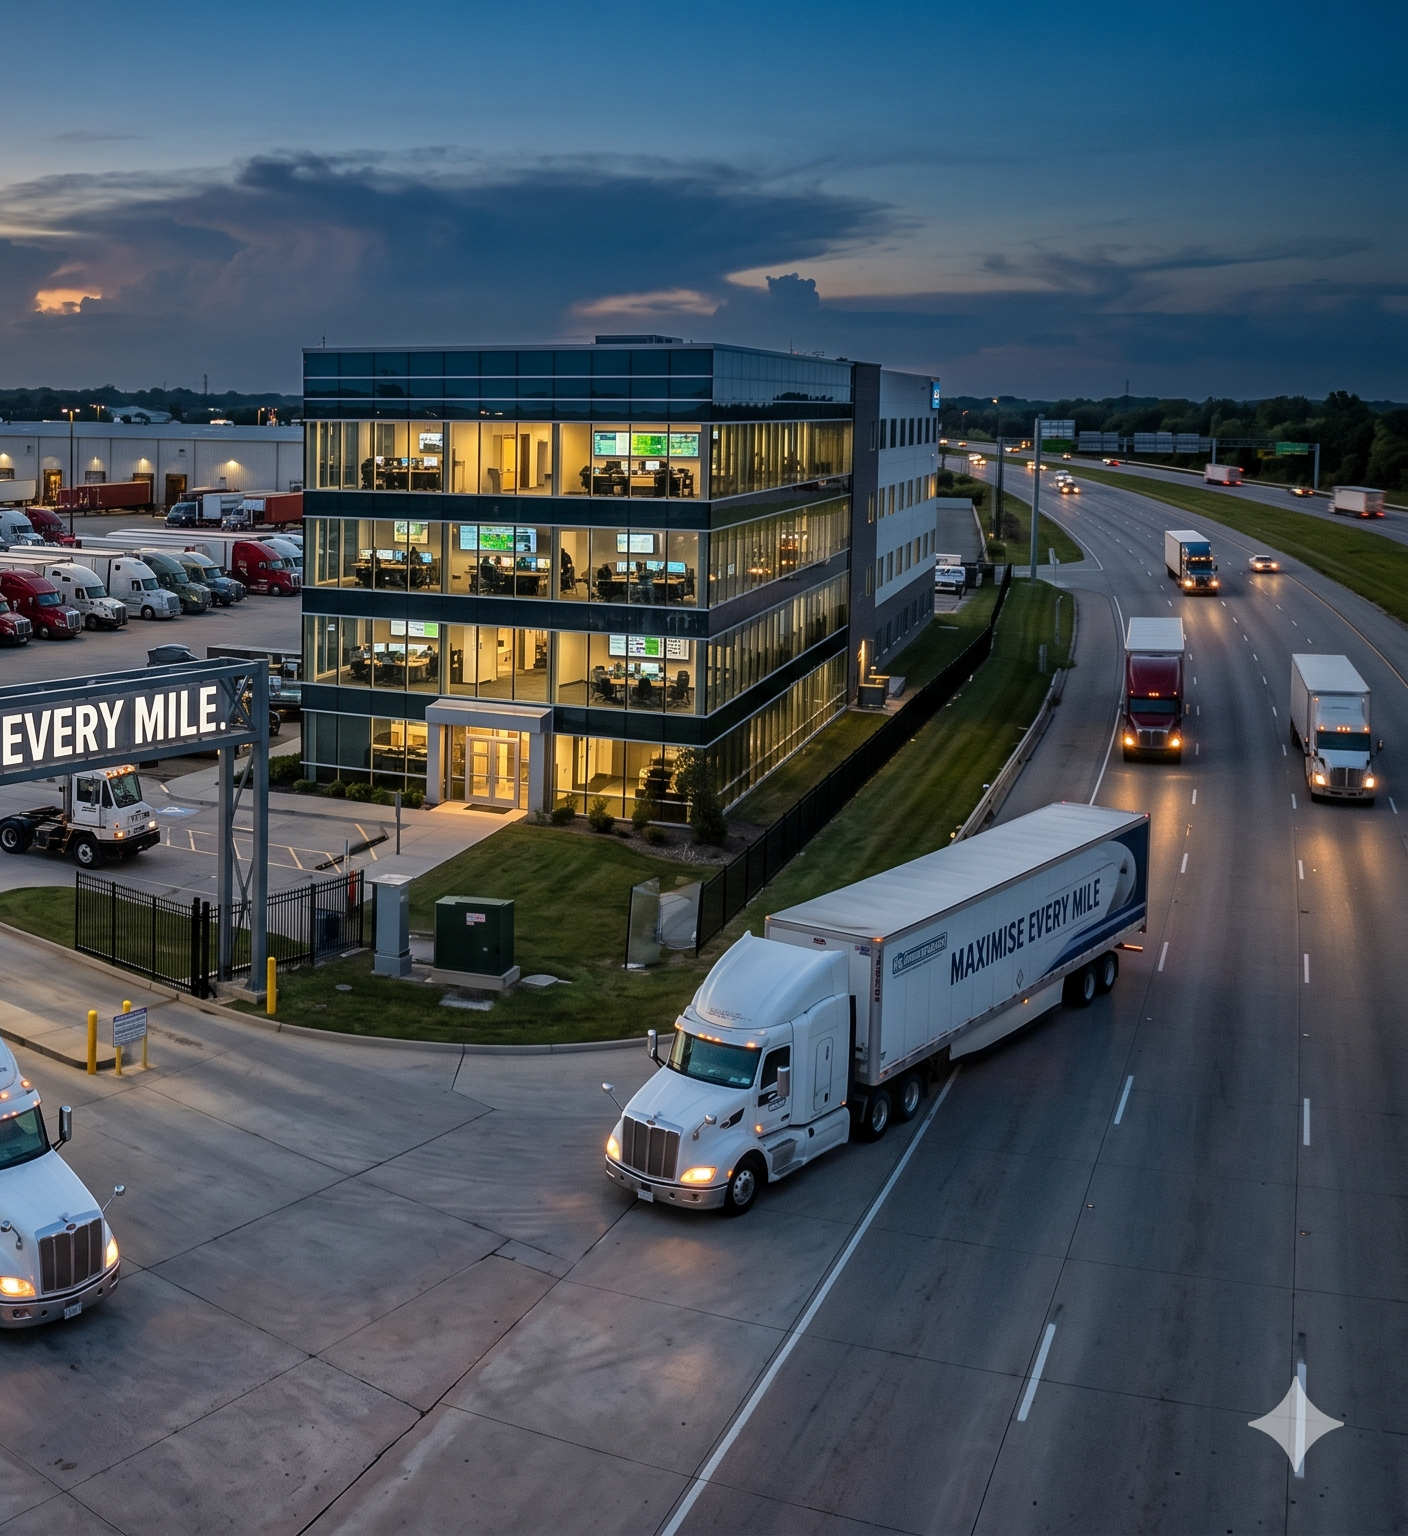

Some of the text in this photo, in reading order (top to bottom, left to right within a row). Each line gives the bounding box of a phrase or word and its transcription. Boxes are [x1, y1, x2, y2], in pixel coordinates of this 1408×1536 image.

[1, 698, 126, 767] EVERY
[134, 684, 227, 745] MILE.
[949, 915, 1026, 987] MAXIMISE
[1027, 894, 1070, 945] EVERY
[1071, 876, 1102, 921] MILE
